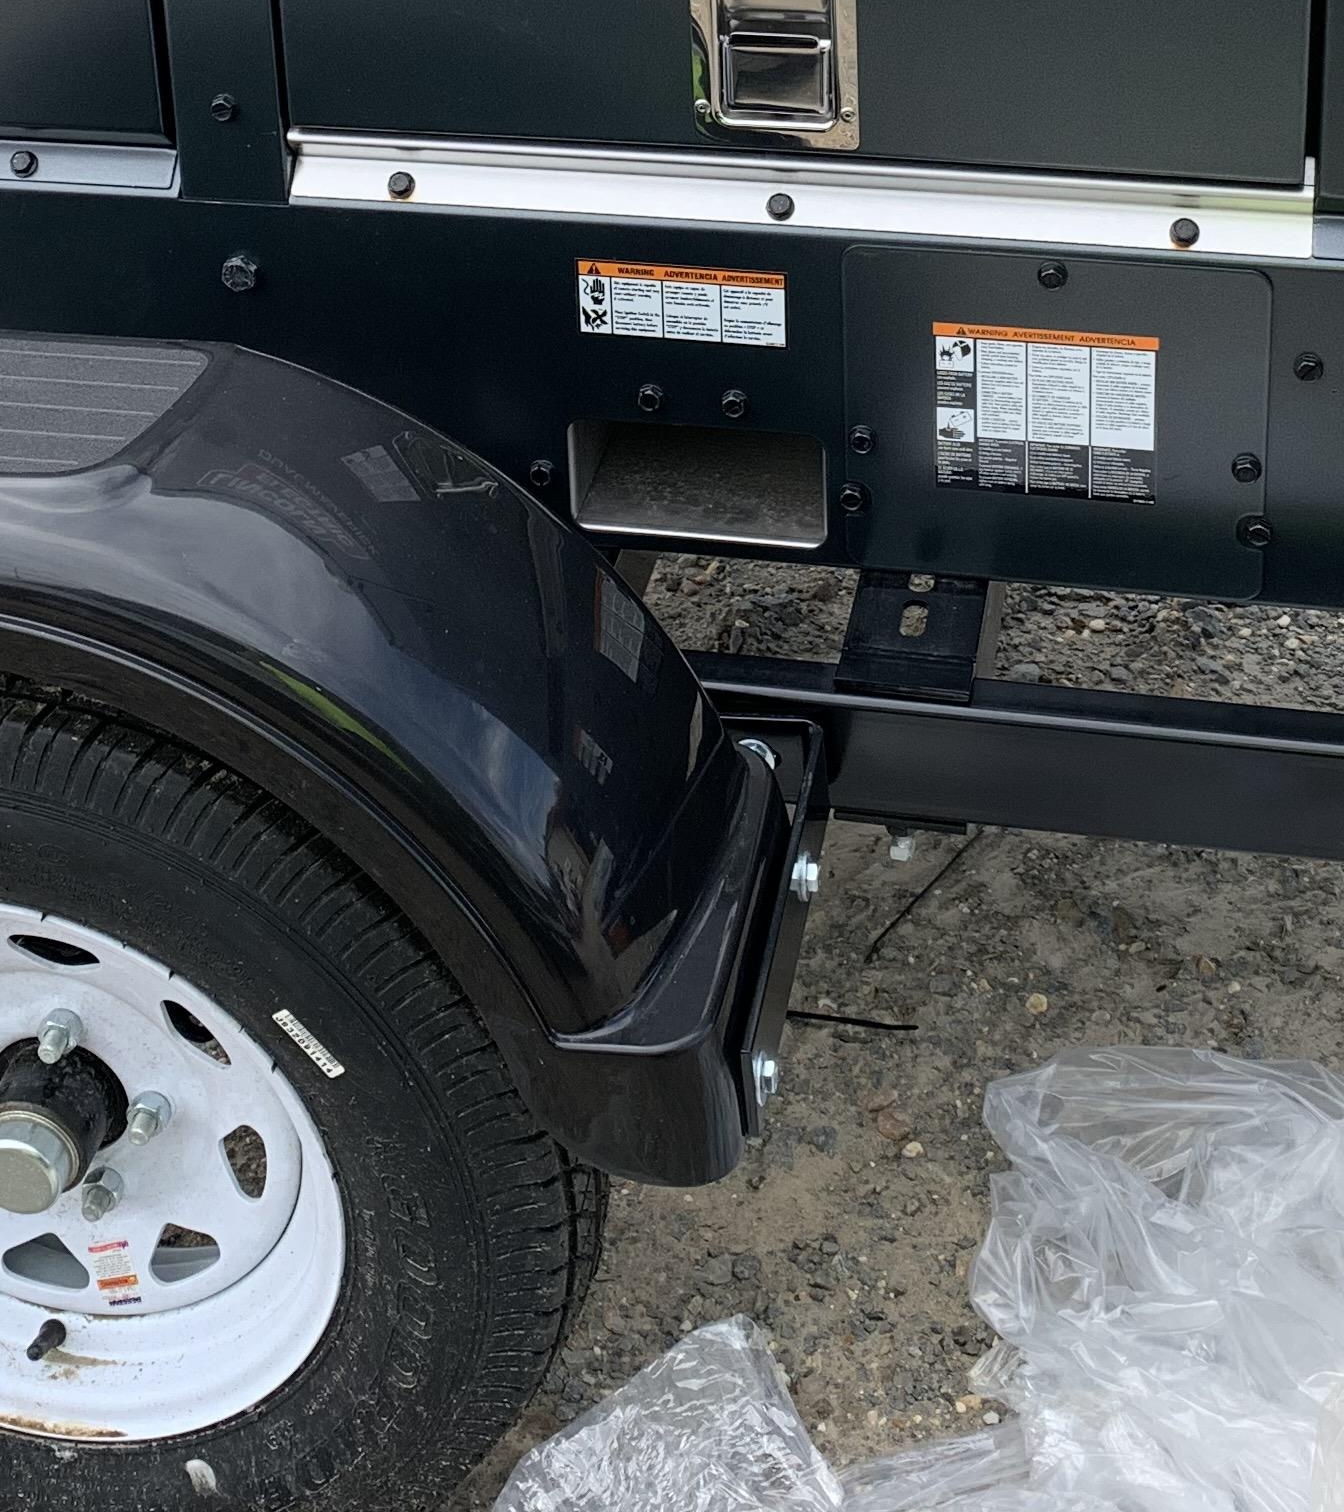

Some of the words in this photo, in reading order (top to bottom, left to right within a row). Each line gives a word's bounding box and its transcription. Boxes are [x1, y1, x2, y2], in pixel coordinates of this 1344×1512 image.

[618, 267, 654, 276] WARNING
[664, 270, 717, 281] ADVERTENCIA
[968, 328, 1008, 337] WARNING
[1013, 331, 1075, 342] AVERTISSEMENT
[1079, 335, 1136, 347] ADVERTENCIA
